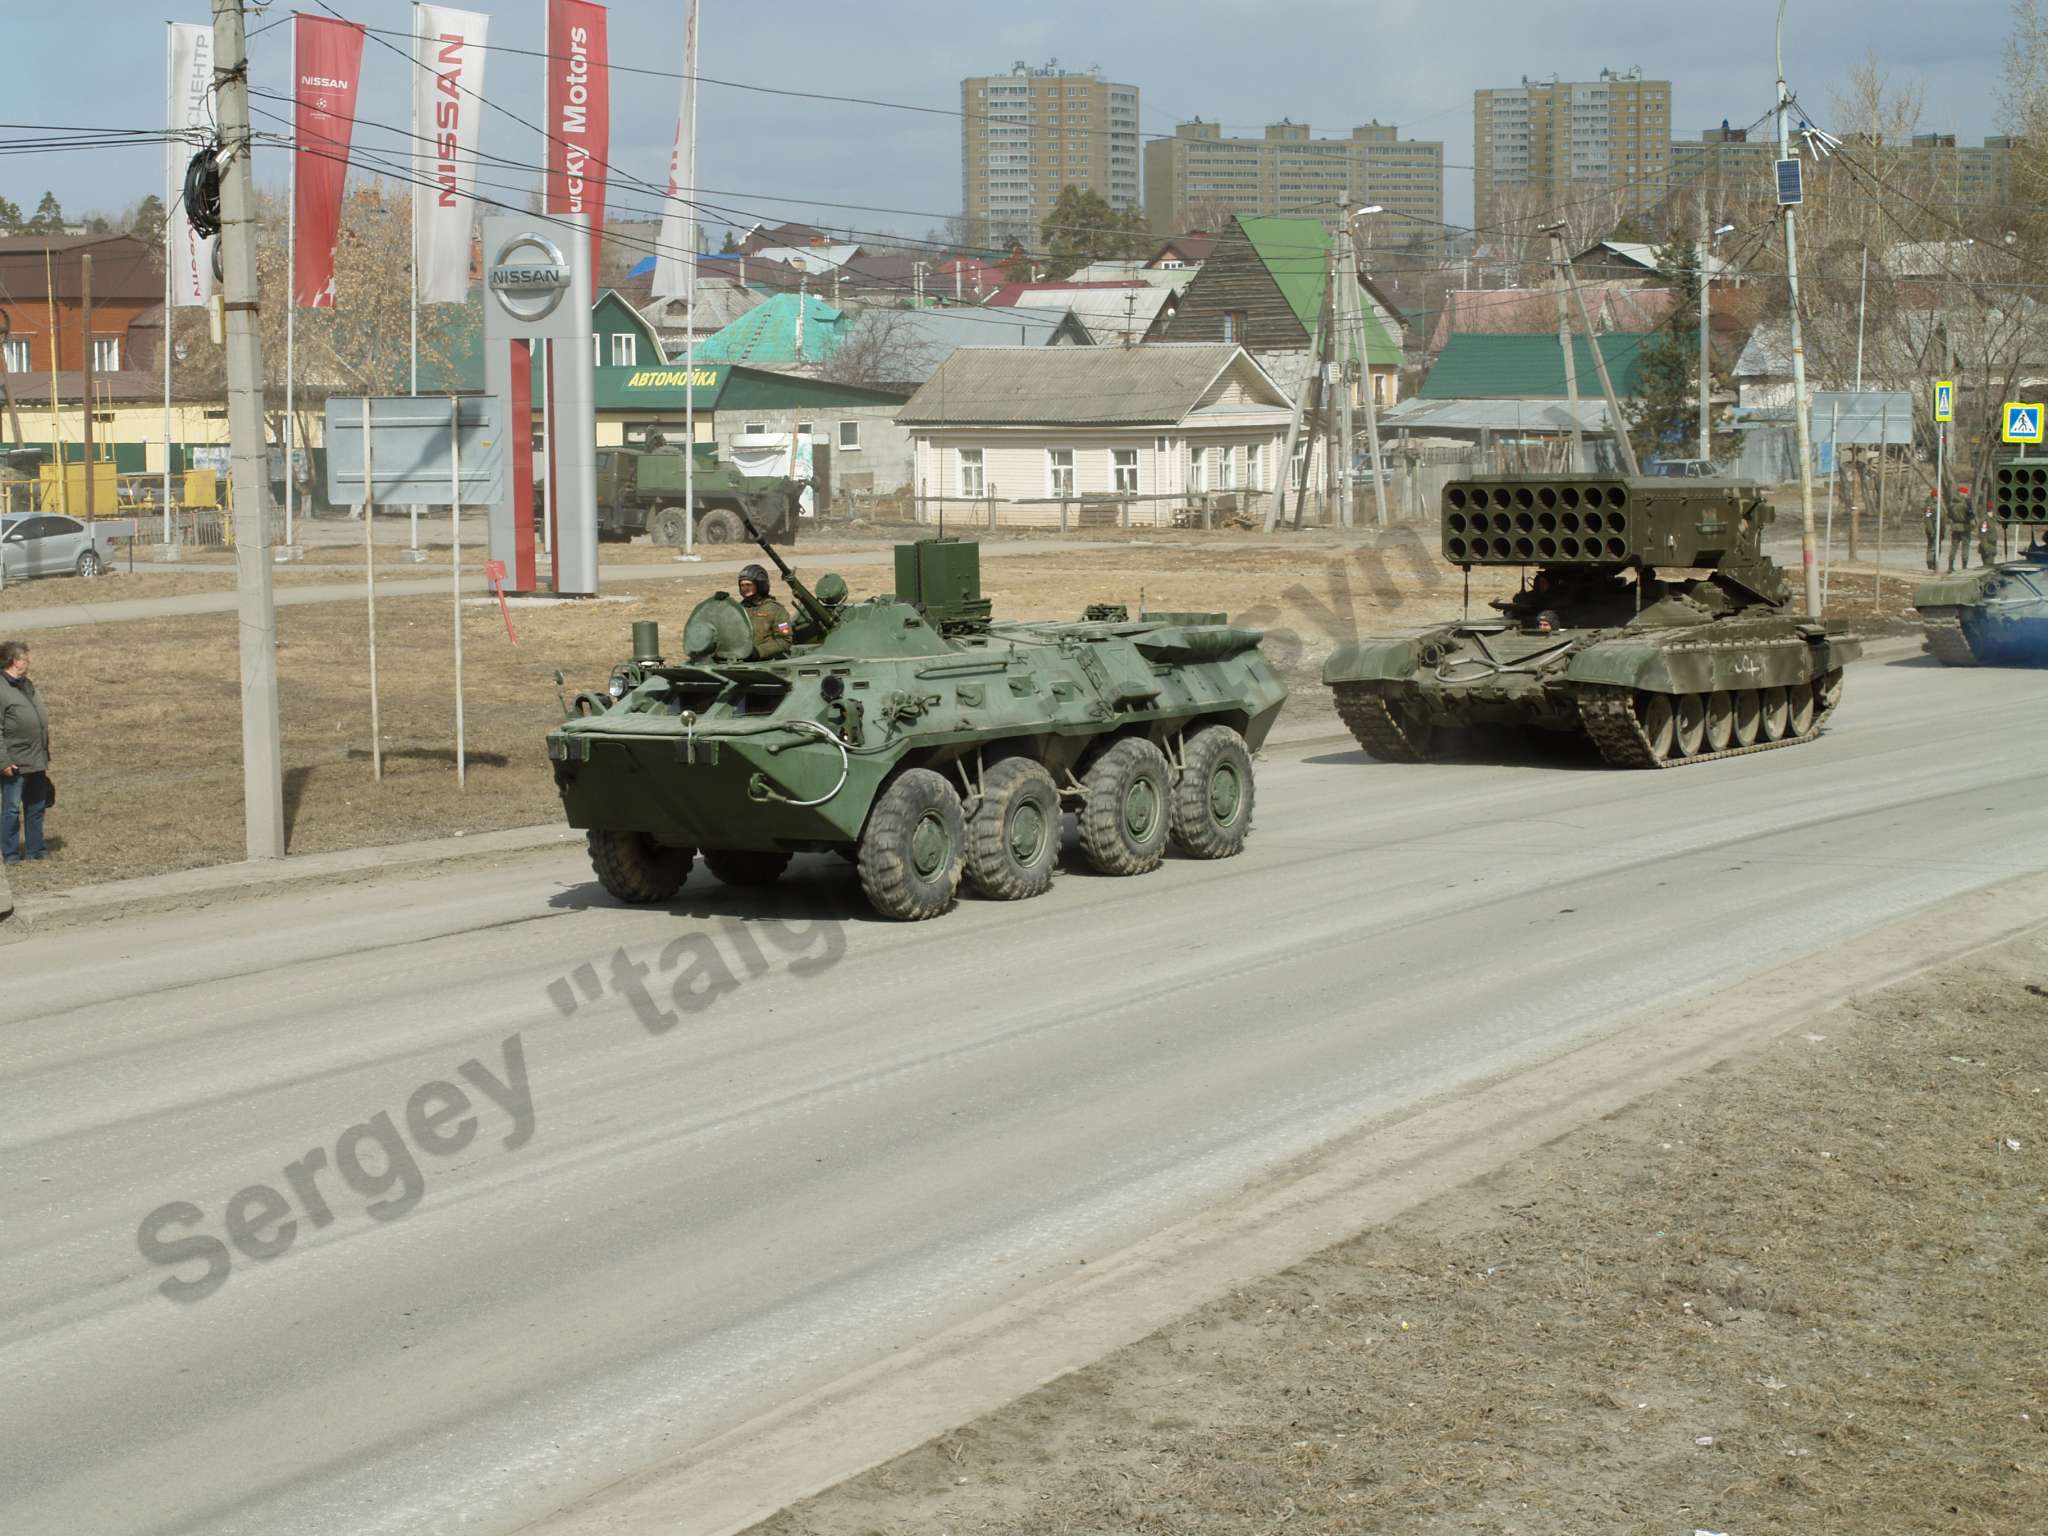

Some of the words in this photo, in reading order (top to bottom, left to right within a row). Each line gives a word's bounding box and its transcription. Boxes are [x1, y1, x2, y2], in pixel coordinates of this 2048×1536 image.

[301, 76, 348, 89] NISSAN
[563, 27, 588, 133] Motors
[437, 33, 465, 207] NISSAN
[565, 142, 590, 213] ucky
[493, 269, 560, 284] NISSAN
[628, 368, 718, 387] АВТОМОЙКА
